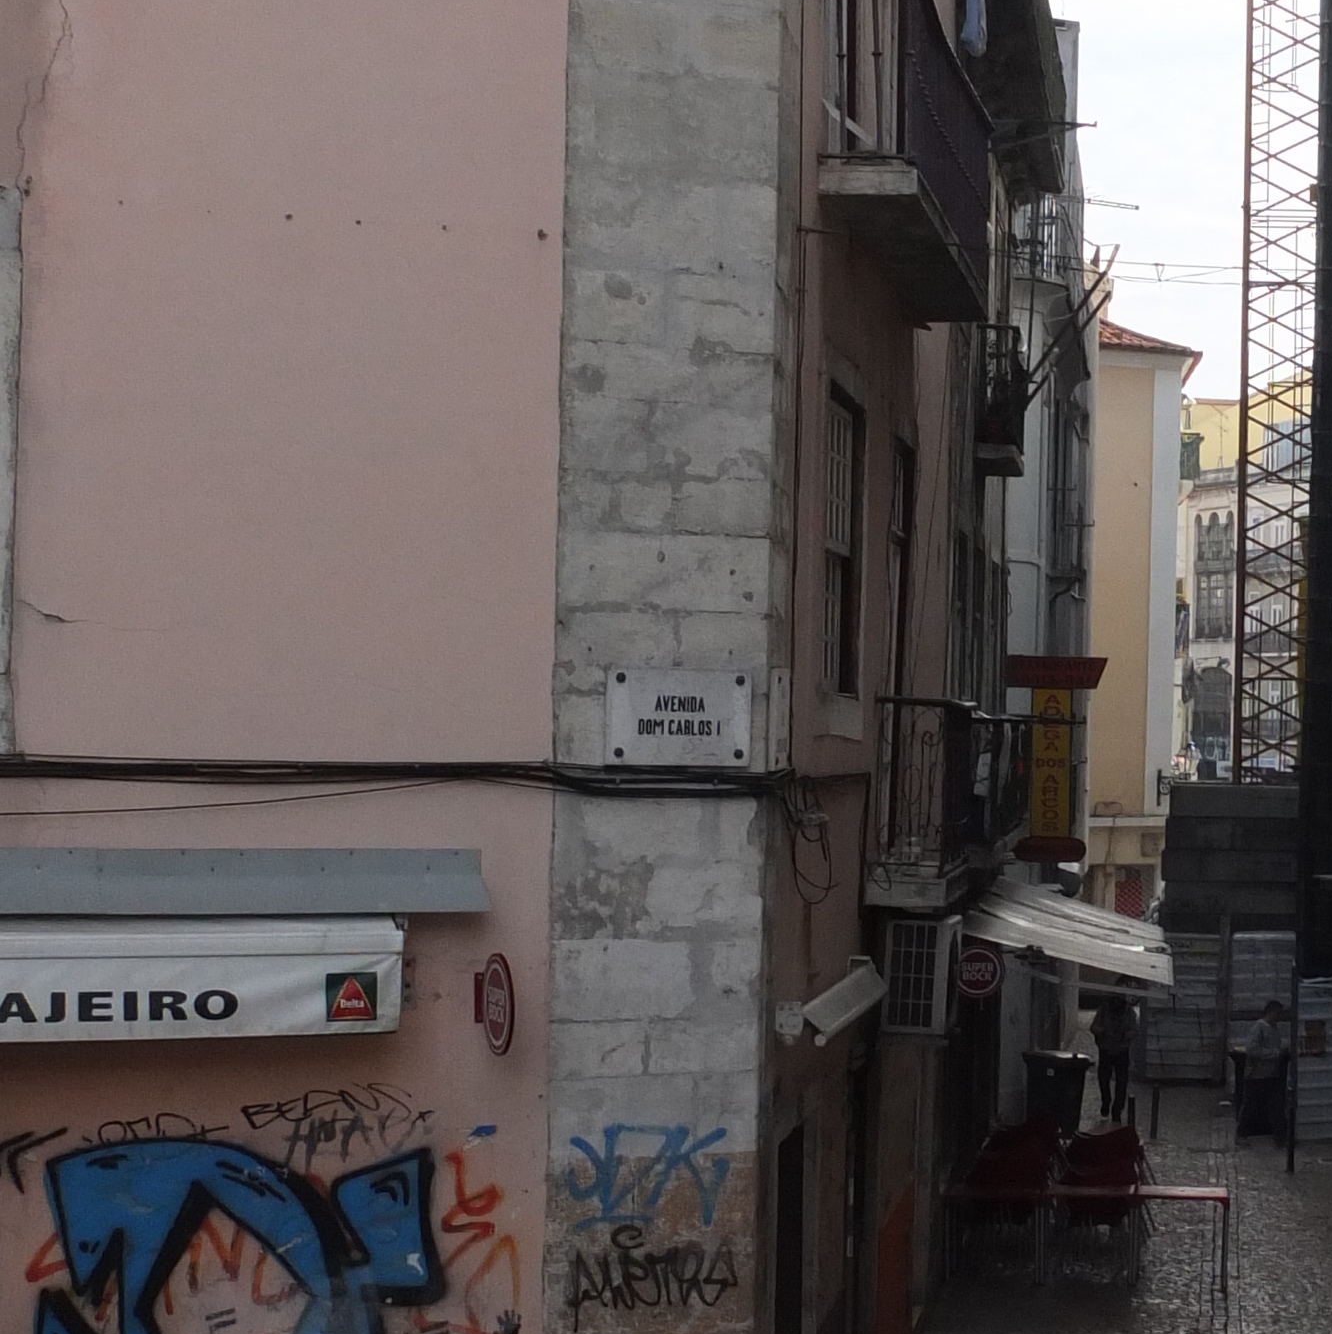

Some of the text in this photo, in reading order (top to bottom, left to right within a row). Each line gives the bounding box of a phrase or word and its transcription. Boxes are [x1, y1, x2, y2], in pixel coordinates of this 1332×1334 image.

[655, 695, 705, 713] AVENIDA
[638, 718, 721, 736] DOM CARLOS I
[961, 961, 995, 972] SUPER
[962, 971, 992, 981] BOCK
[0, 990, 239, 1024] AJEIRO
[340, 998, 365, 1009] Delta
